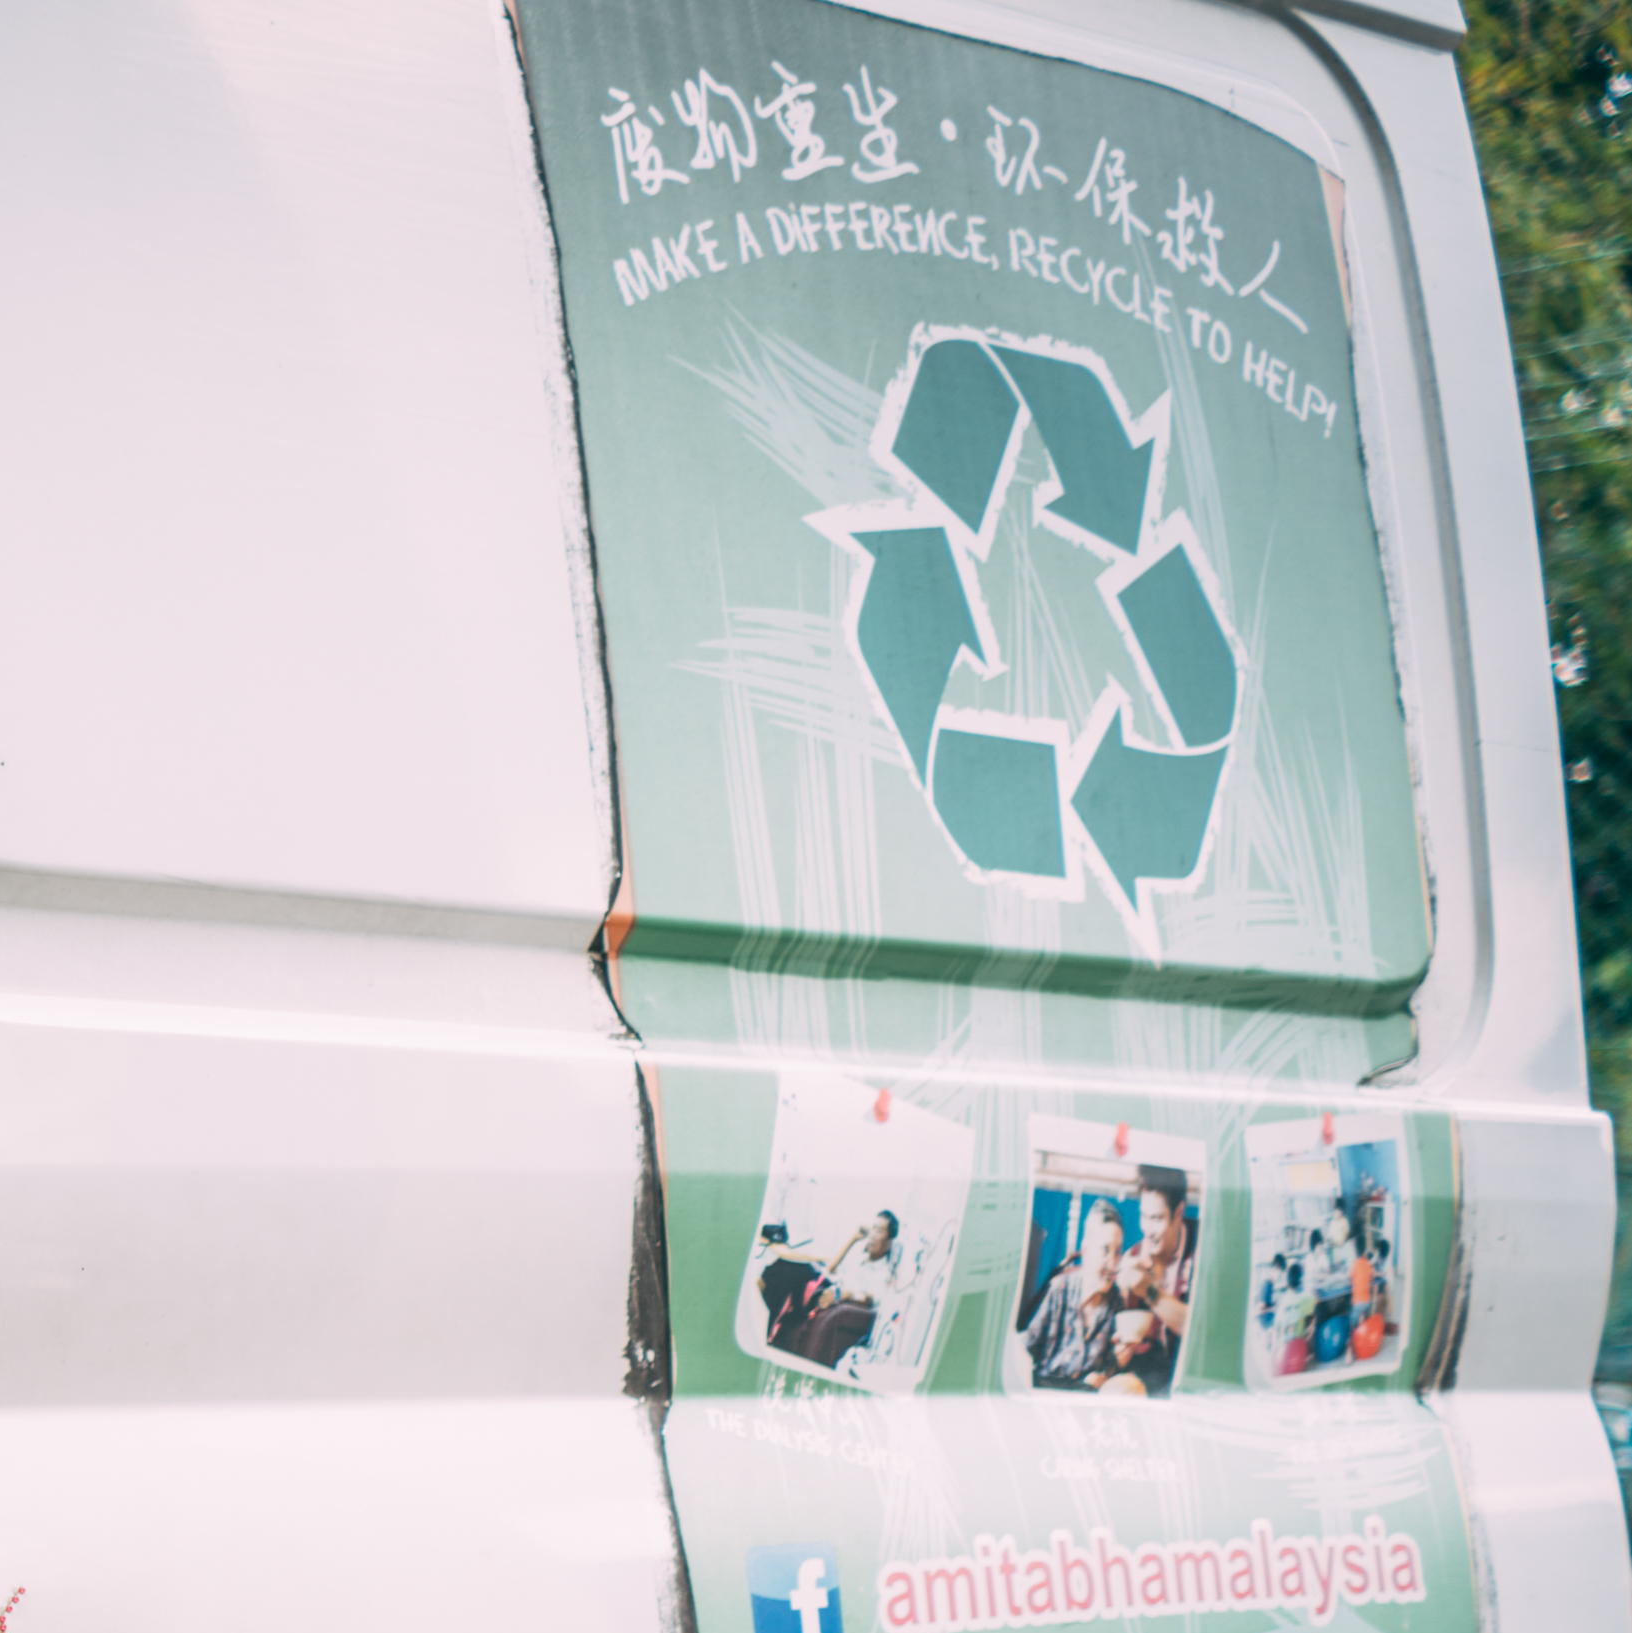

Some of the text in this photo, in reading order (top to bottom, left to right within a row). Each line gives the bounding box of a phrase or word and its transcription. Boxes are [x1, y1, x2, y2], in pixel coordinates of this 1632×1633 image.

[614, 220, 728, 306] MAKE
[739, 213, 765, 265] A
[1010, 228, 1173, 333] RECYCLE
[1187, 306, 1233, 364] TO
[1243, 341, 1337, 439] HELP!
[885, 1524, 1419, 1628] amitabhamalaysia
